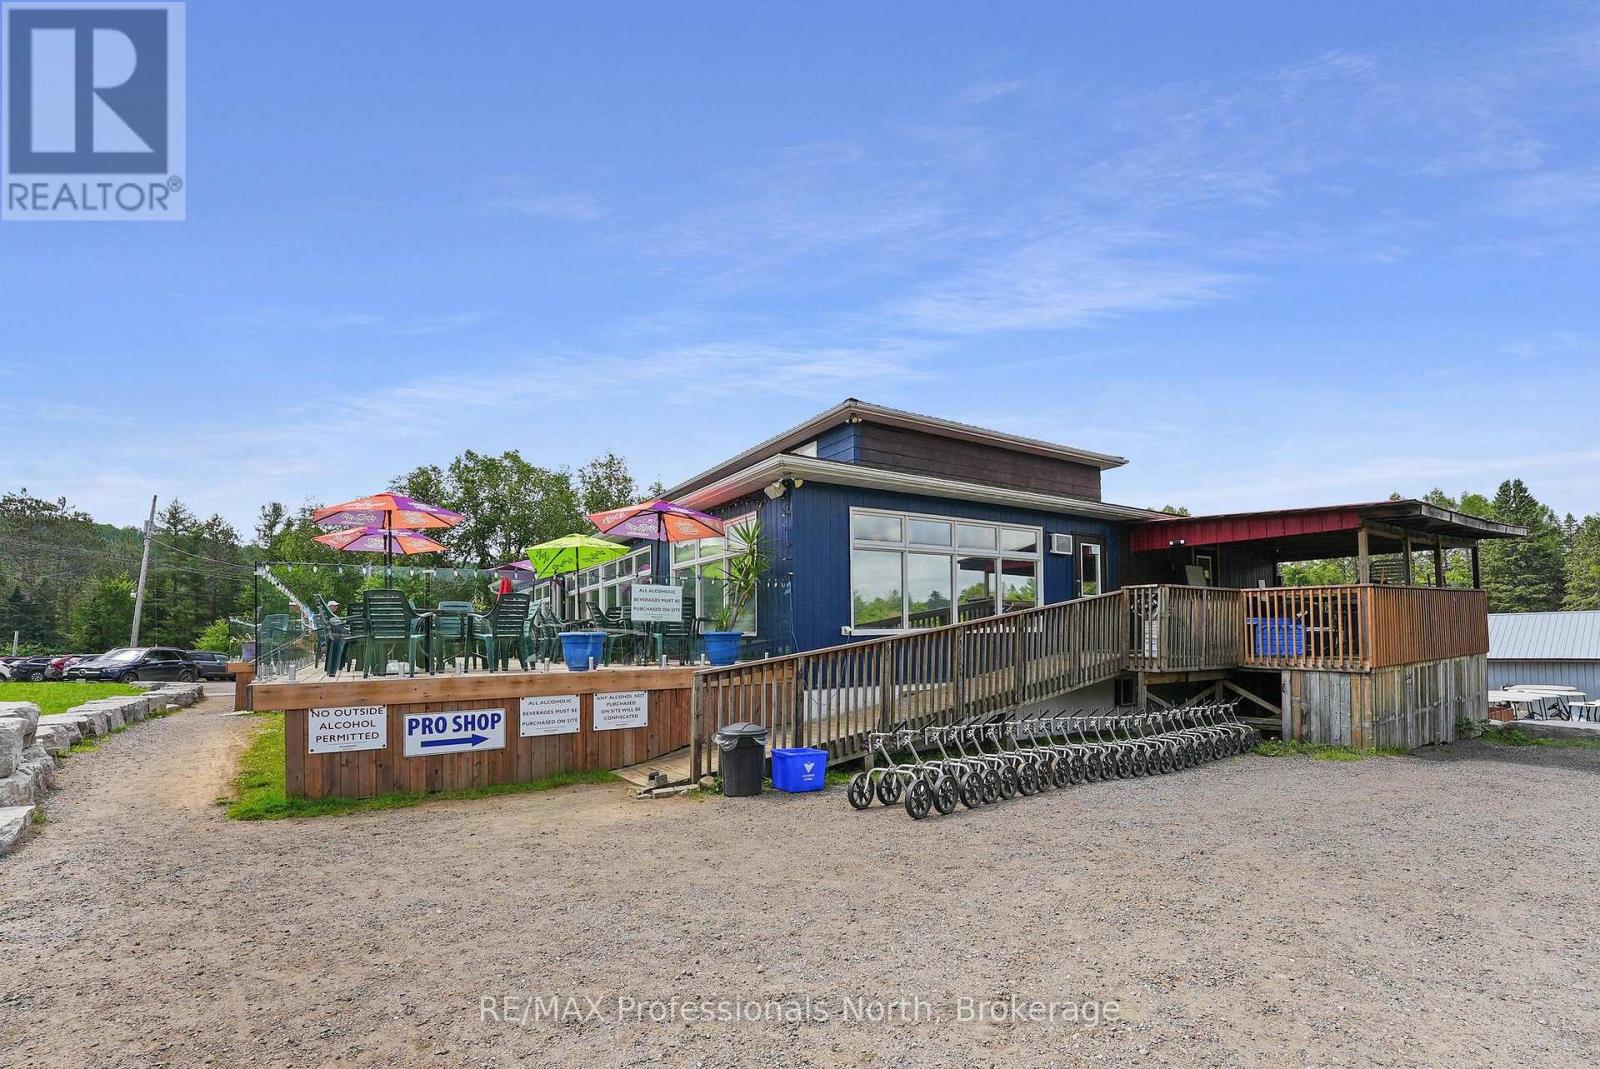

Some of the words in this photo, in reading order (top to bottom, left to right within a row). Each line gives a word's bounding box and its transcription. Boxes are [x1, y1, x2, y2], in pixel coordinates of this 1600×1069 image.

[311, 709, 330, 718] NO
[334, 707, 384, 717] OUTSIDE
[603, 713, 639, 721] CONFISCATED
[319, 720, 376, 730] ALCOHOL
[407, 716, 448, 736] PRO
[452, 712, 502, 733] SHOP
[315, 731, 380, 743] PERMITTED
